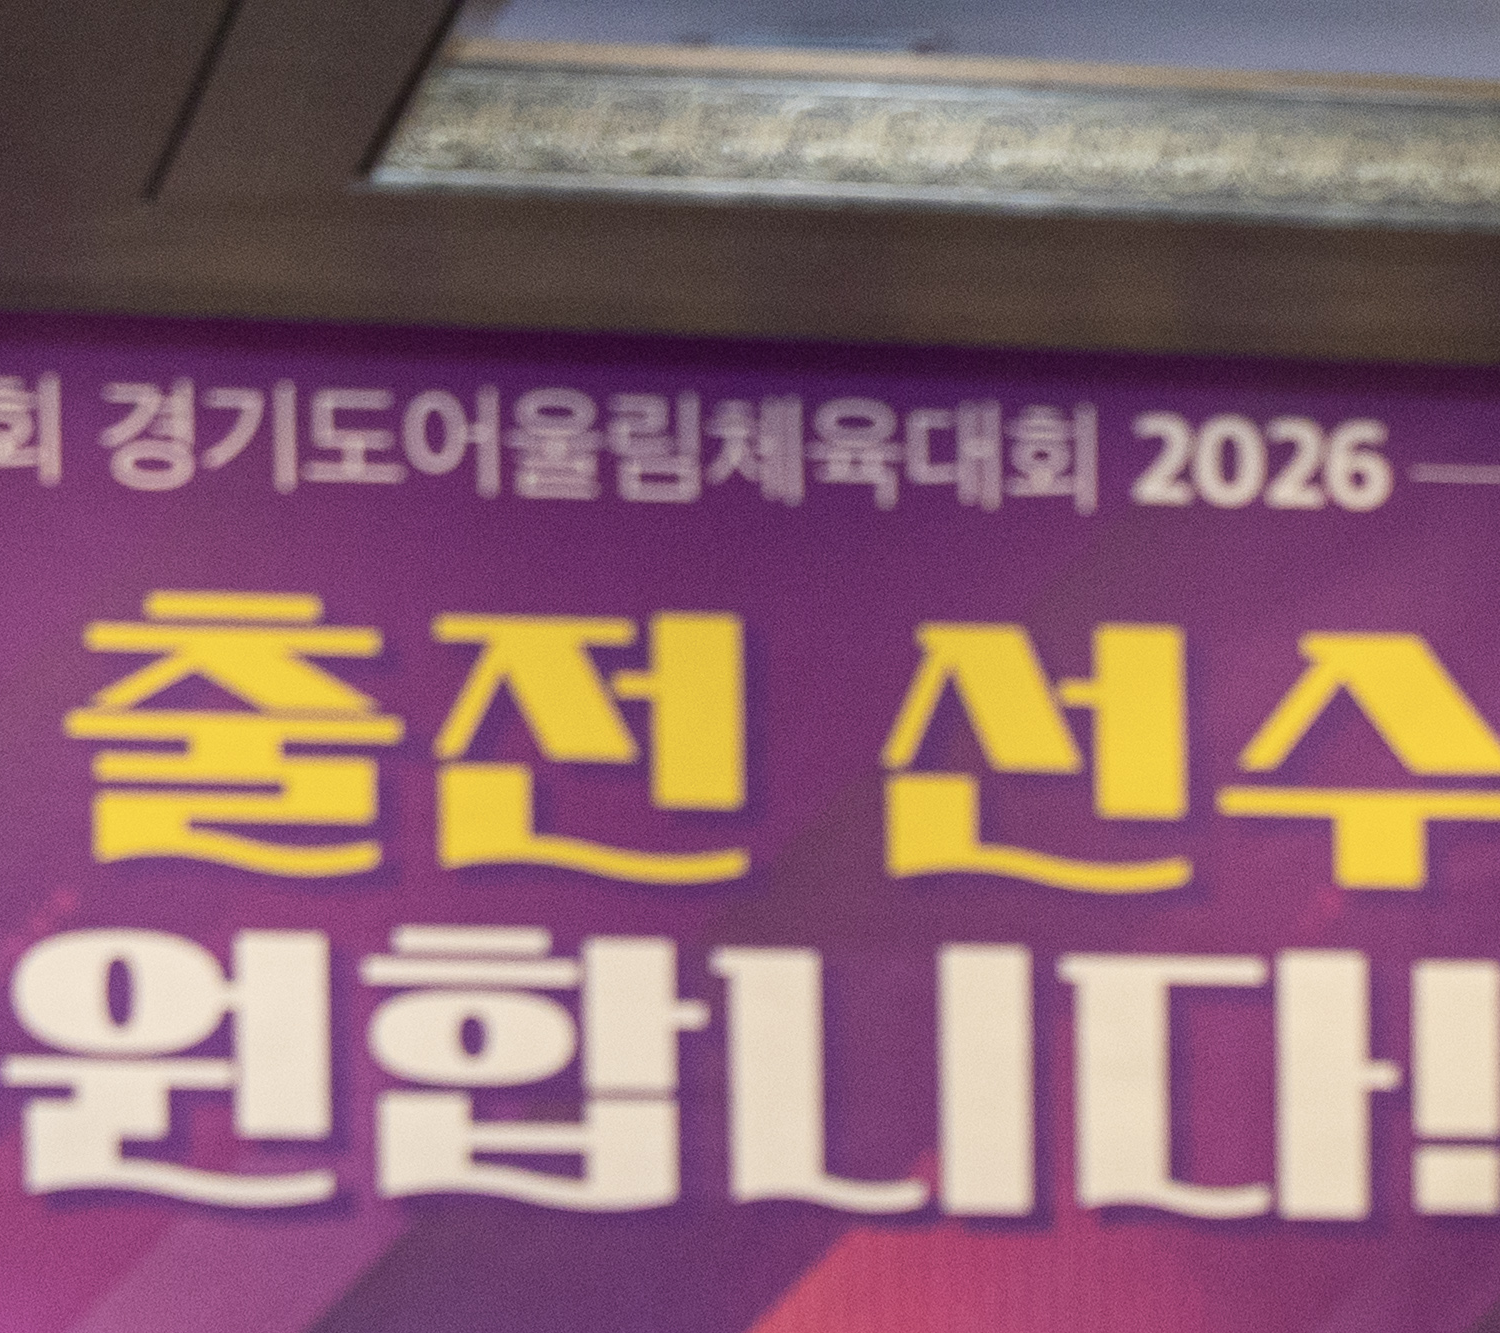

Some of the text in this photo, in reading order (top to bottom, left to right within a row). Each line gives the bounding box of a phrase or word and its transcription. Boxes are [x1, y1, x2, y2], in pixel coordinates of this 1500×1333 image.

[101, 381, 1098, 511] 경기도어울림체육대회
[1130, 412, 1393, 512] 2026
[61, 588, 748, 883] 출전
